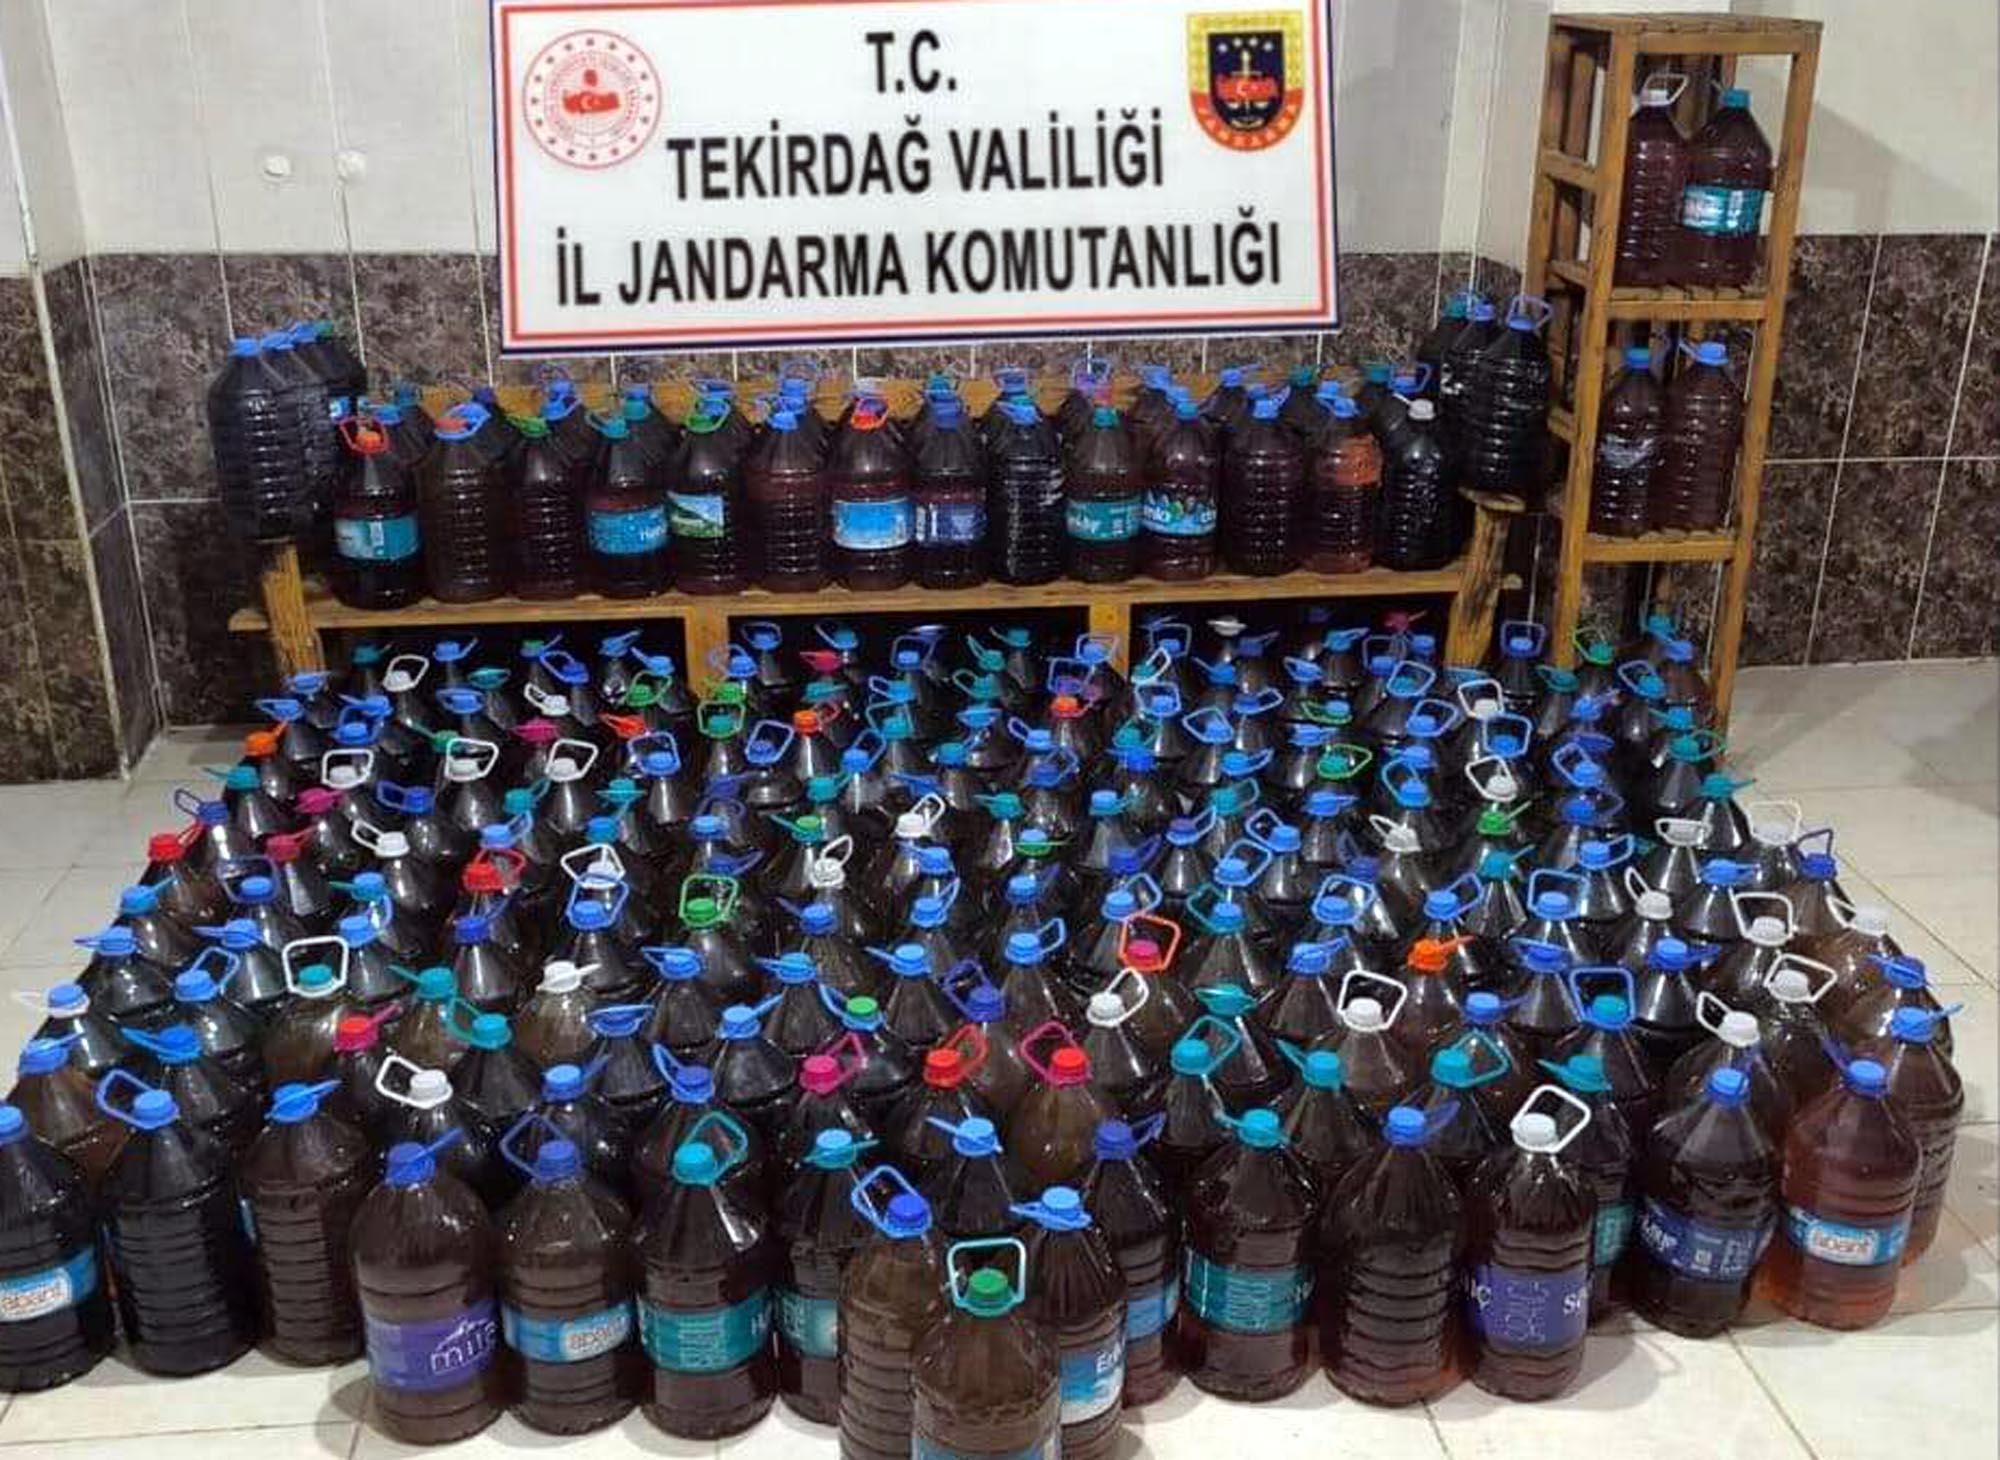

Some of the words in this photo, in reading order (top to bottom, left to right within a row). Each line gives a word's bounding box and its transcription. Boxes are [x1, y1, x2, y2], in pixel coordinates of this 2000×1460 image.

[866, 31, 956, 93] T.C.
[667, 116, 931, 200] TEKİRDAĞ
[949, 108, 1163, 191] VALİLİĞİ
[557, 227, 602, 305] İL
[619, 233, 908, 305] JANDARMA
[926, 206, 1281, 294] KOMUTANLIĞI
